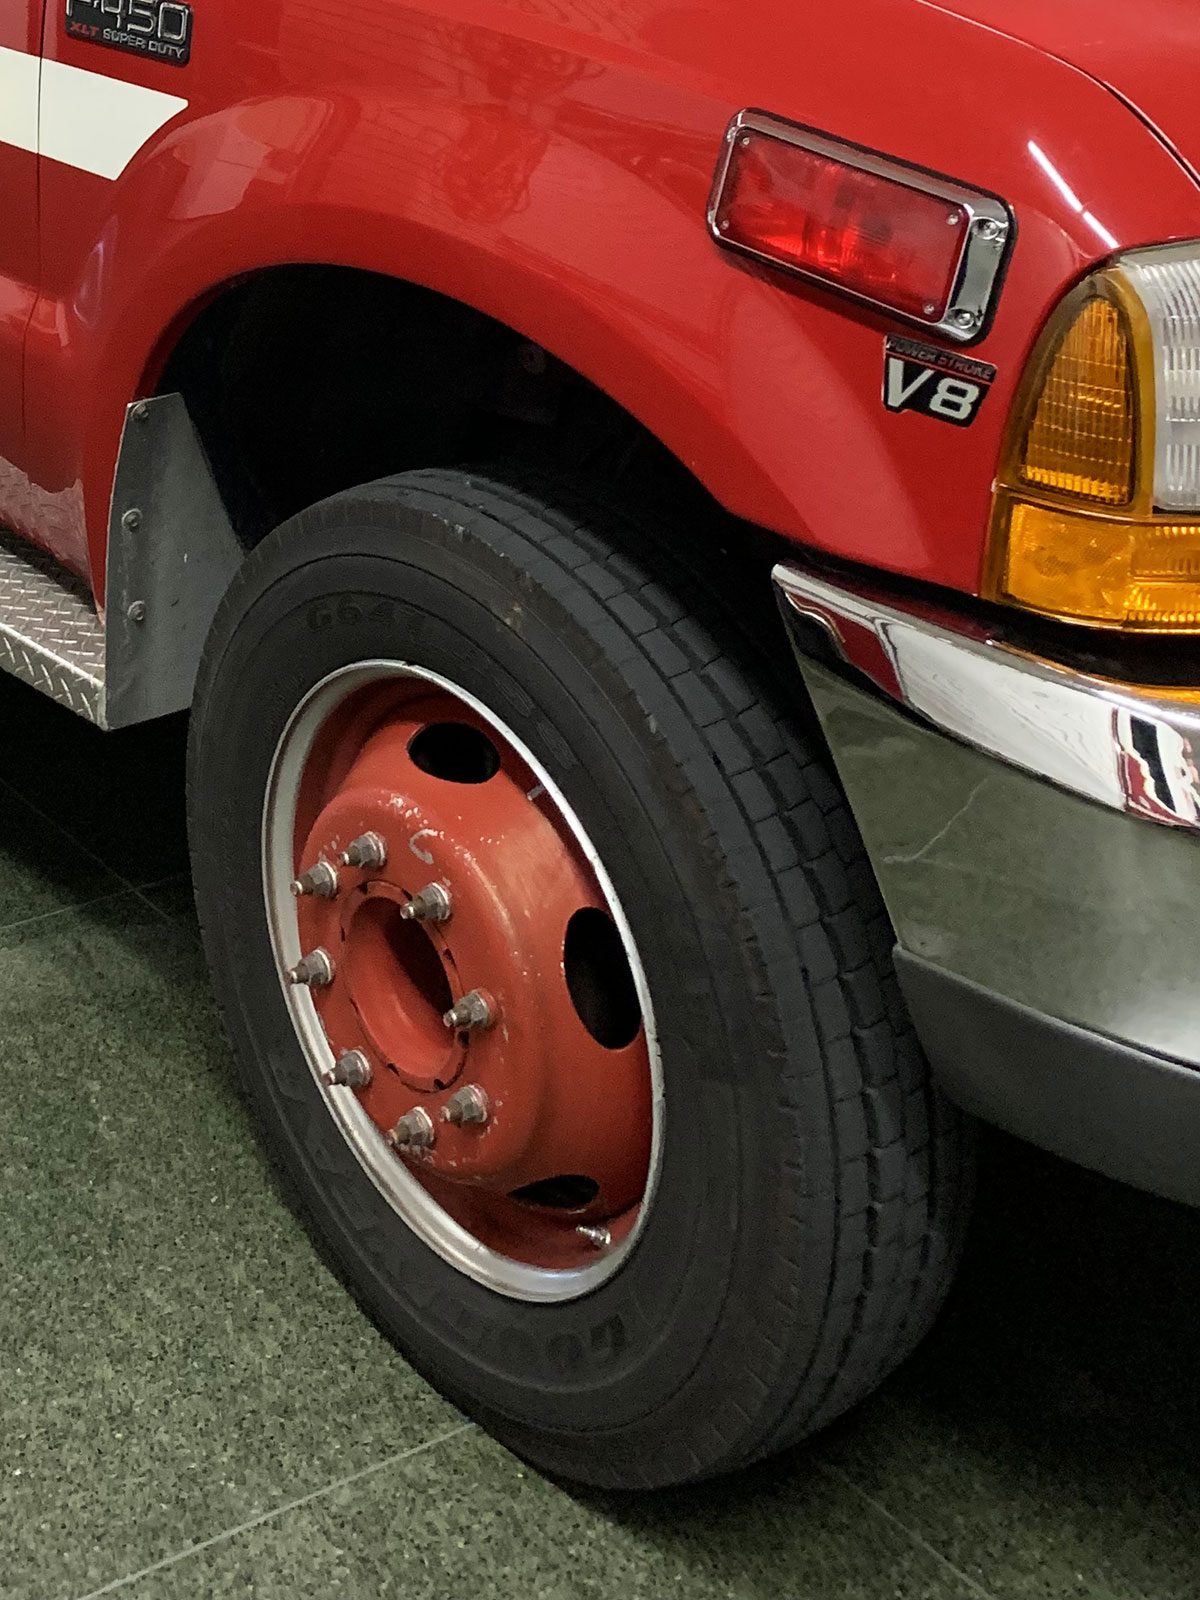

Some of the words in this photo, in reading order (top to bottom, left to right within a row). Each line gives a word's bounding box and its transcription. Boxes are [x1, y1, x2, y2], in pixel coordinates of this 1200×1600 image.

[70, 21, 100, 37] XLT
[102, 28, 143, 47] SUPER
[148, 40, 185, 58] DUTY
[889, 337, 937, 362] POWER
[937, 353, 994, 380] STROKE
[887, 357, 980, 420] V8
